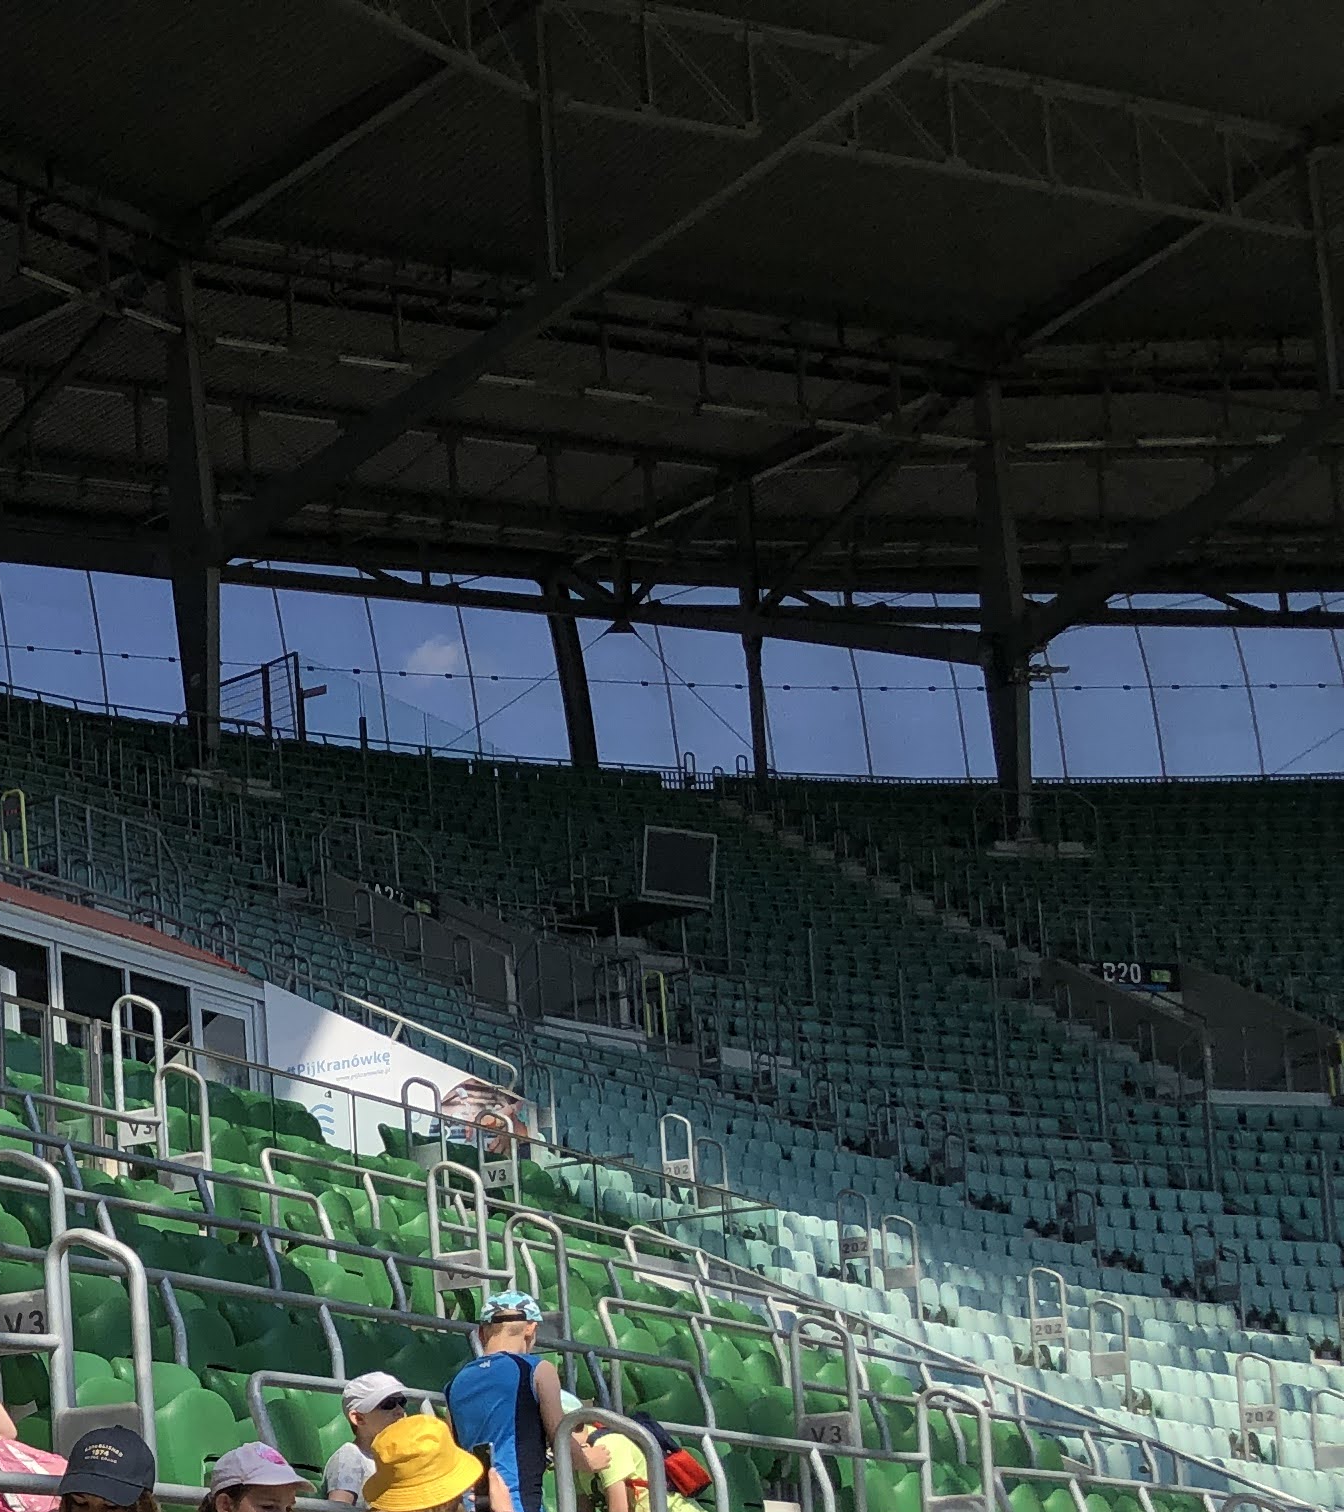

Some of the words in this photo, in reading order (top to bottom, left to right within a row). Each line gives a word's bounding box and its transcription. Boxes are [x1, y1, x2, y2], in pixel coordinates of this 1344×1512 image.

[487, 1168, 507, 1183] V3
[842, 1242, 868, 1254] 202
[3, 1310, 45, 1334] V3
[1035, 1324, 1062, 1336] 202
[1245, 1411, 1275, 1423] 202
[811, 1425, 842, 1444] V3
